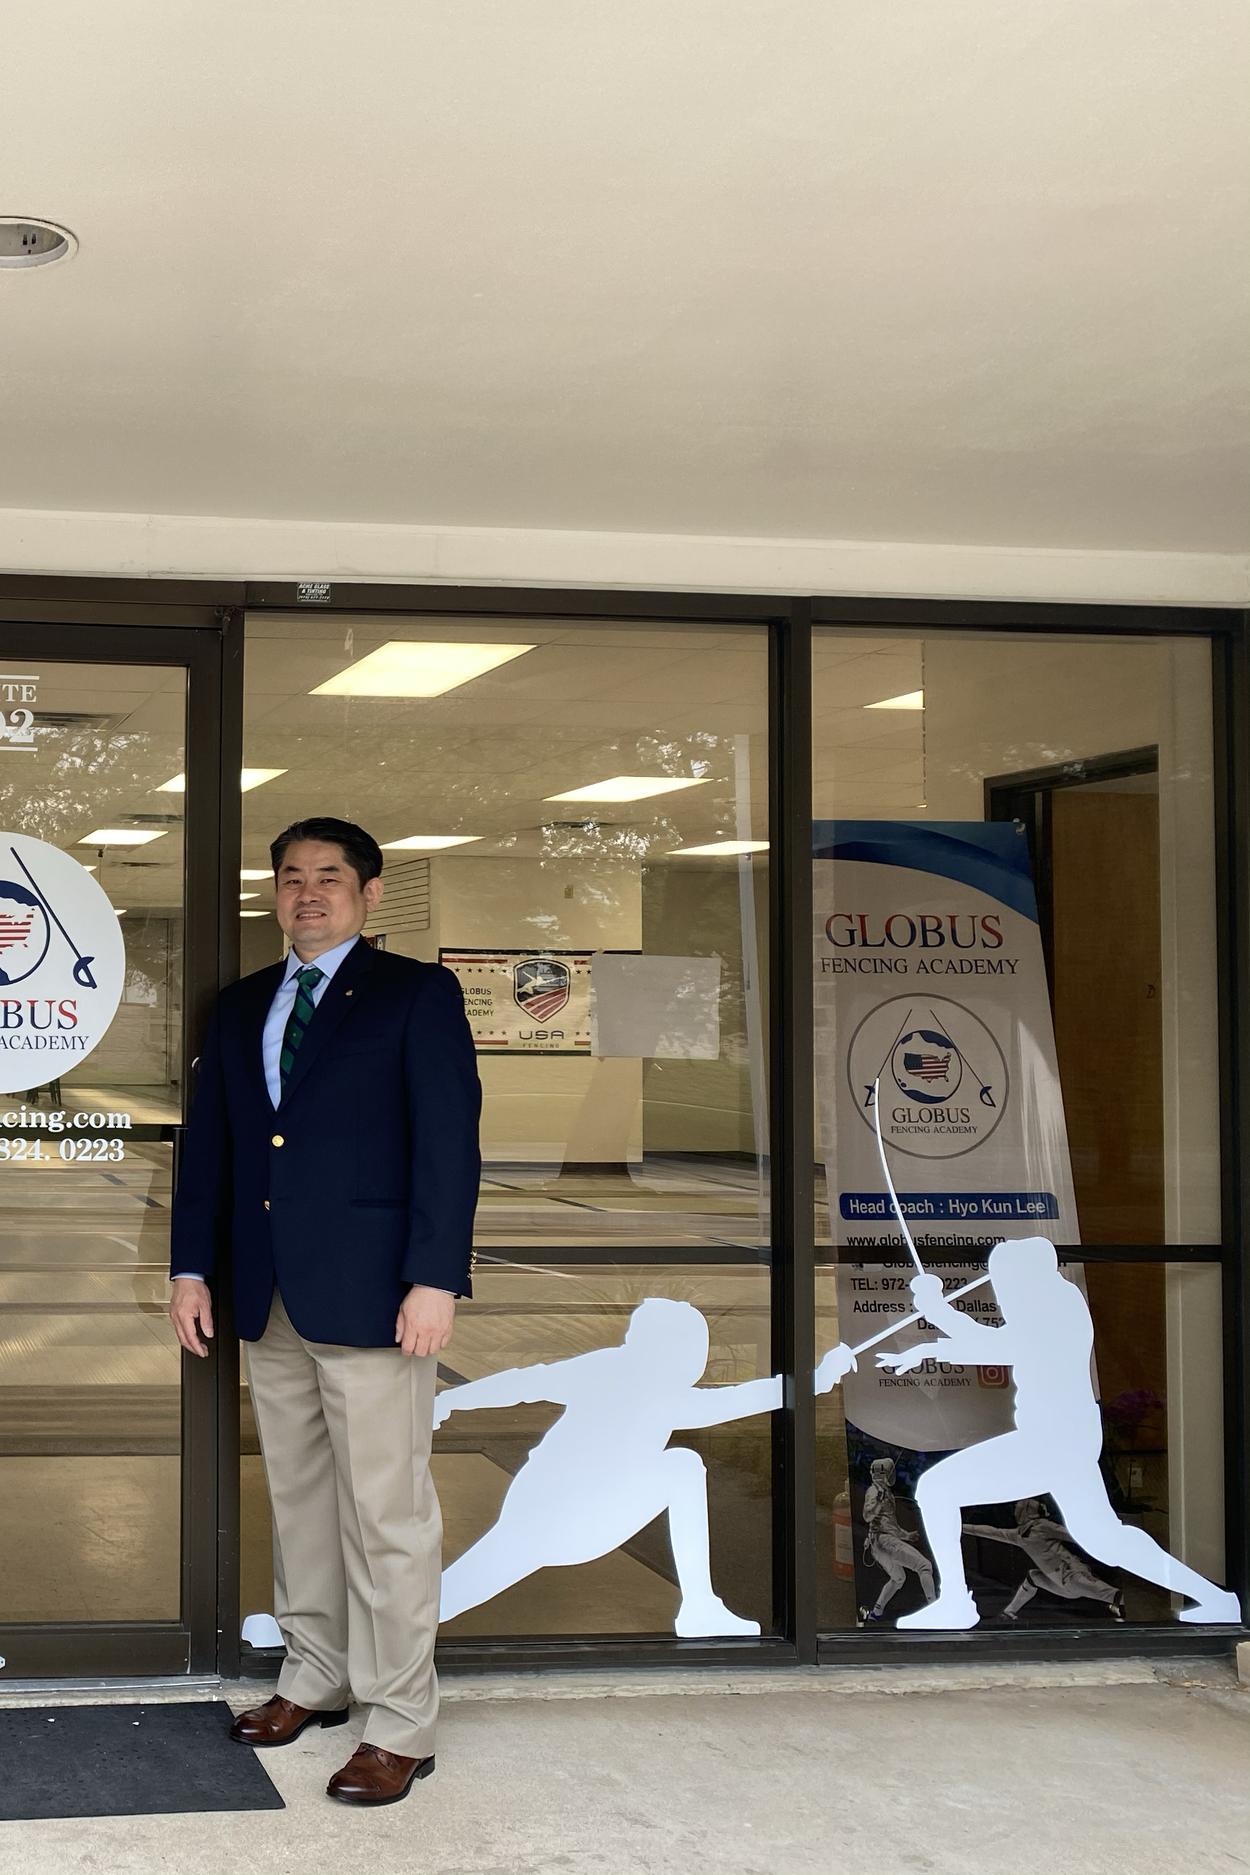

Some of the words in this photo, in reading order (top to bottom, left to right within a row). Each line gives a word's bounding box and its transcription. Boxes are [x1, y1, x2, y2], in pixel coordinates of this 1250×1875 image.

[825, 913, 1004, 949] GLOBUS
[821, 957, 909, 974] FENCING
[916, 958, 1020, 975] ACADEMY
[464, 998, 493, 1007] ENCING
[519, 1030, 565, 1041] USA
[892, 1107, 971, 1124] GLOBUS
[890, 1125, 931, 1134] FENCING
[933, 1125, 978, 1134] ACADEMY
[59, 1138, 126, 1162] 0223
[850, 1199, 886, 1214] Head
[949, 1199, 979, 1217] Hyo
[982, 1199, 1013, 1214] Kun
[1016, 1199, 1046, 1214] Lee
[851, 1278, 878, 1291] TEL:
[853, 1300, 906, 1313] Address
[956, 1300, 997, 1313] Dallas
[878, 1378, 921, 1387] FENCING
[924, 1378, 971, 1388] ACADEMY
